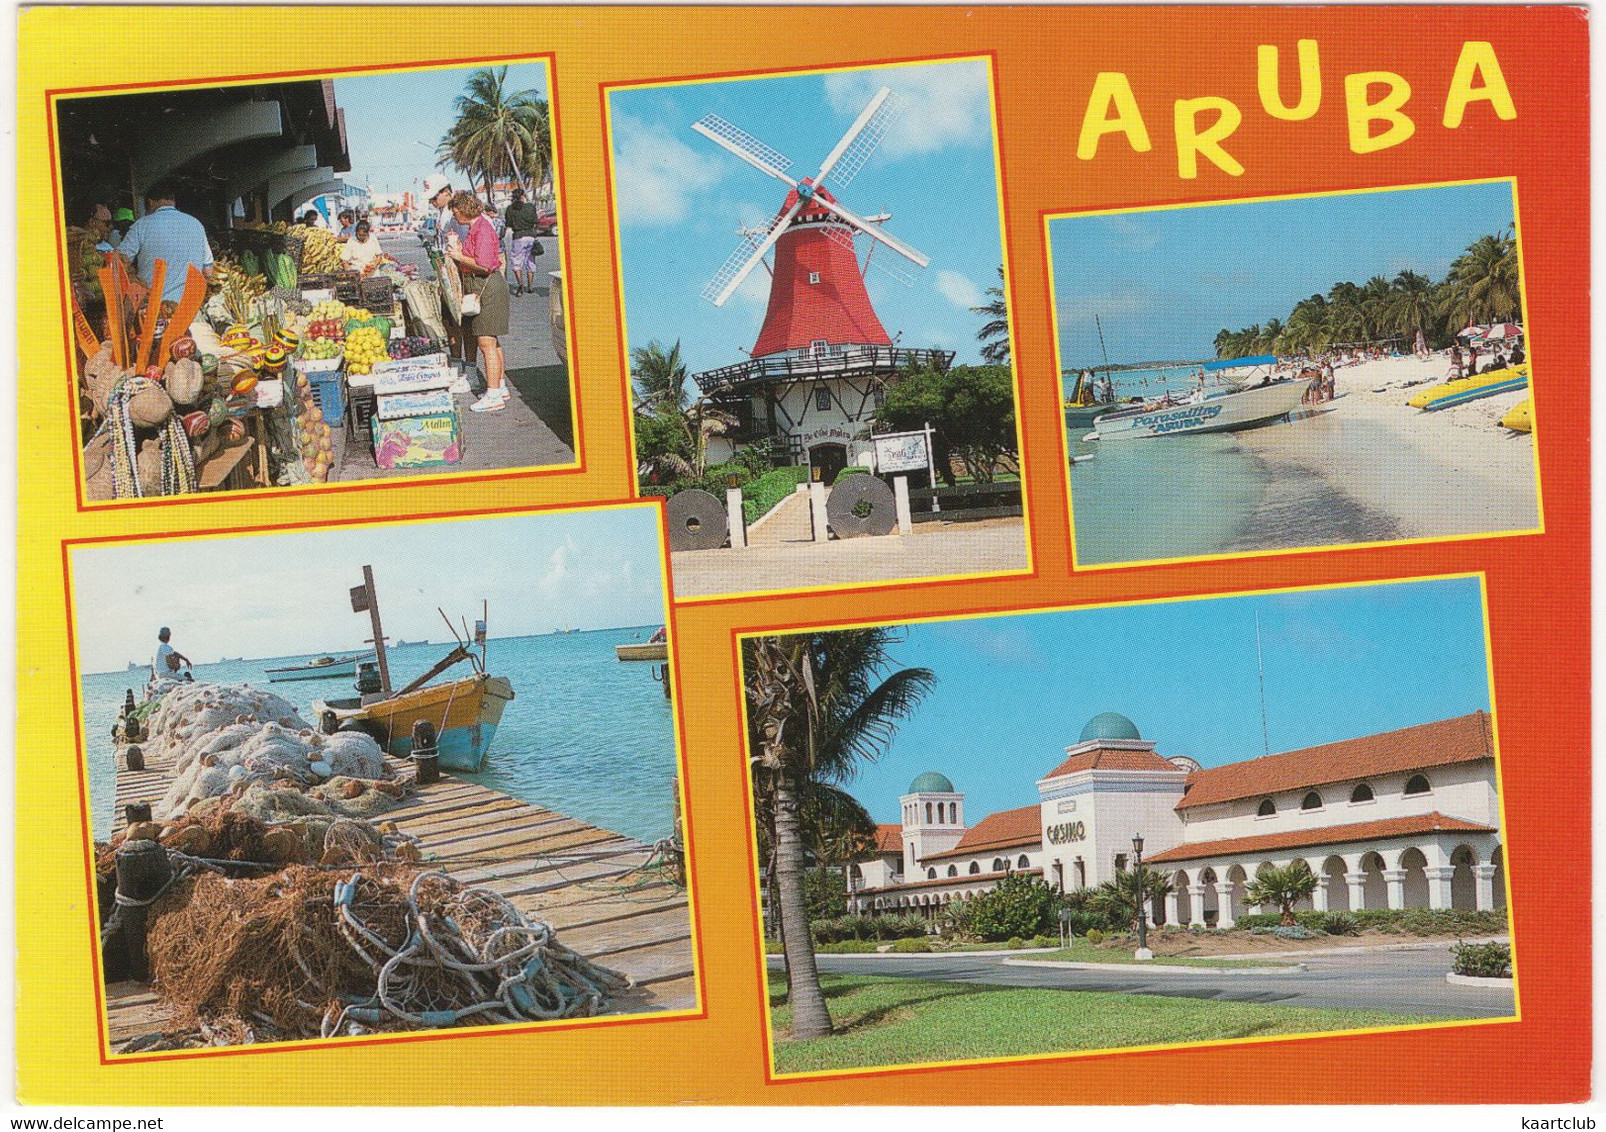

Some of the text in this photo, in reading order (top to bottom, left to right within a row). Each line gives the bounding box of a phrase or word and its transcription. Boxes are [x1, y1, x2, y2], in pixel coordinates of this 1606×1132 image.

[1077, 38, 1517, 179] ARUBA
[1132, 405, 1222, 428] Parasailing
[1047, 820, 1086, 845] CASINO
